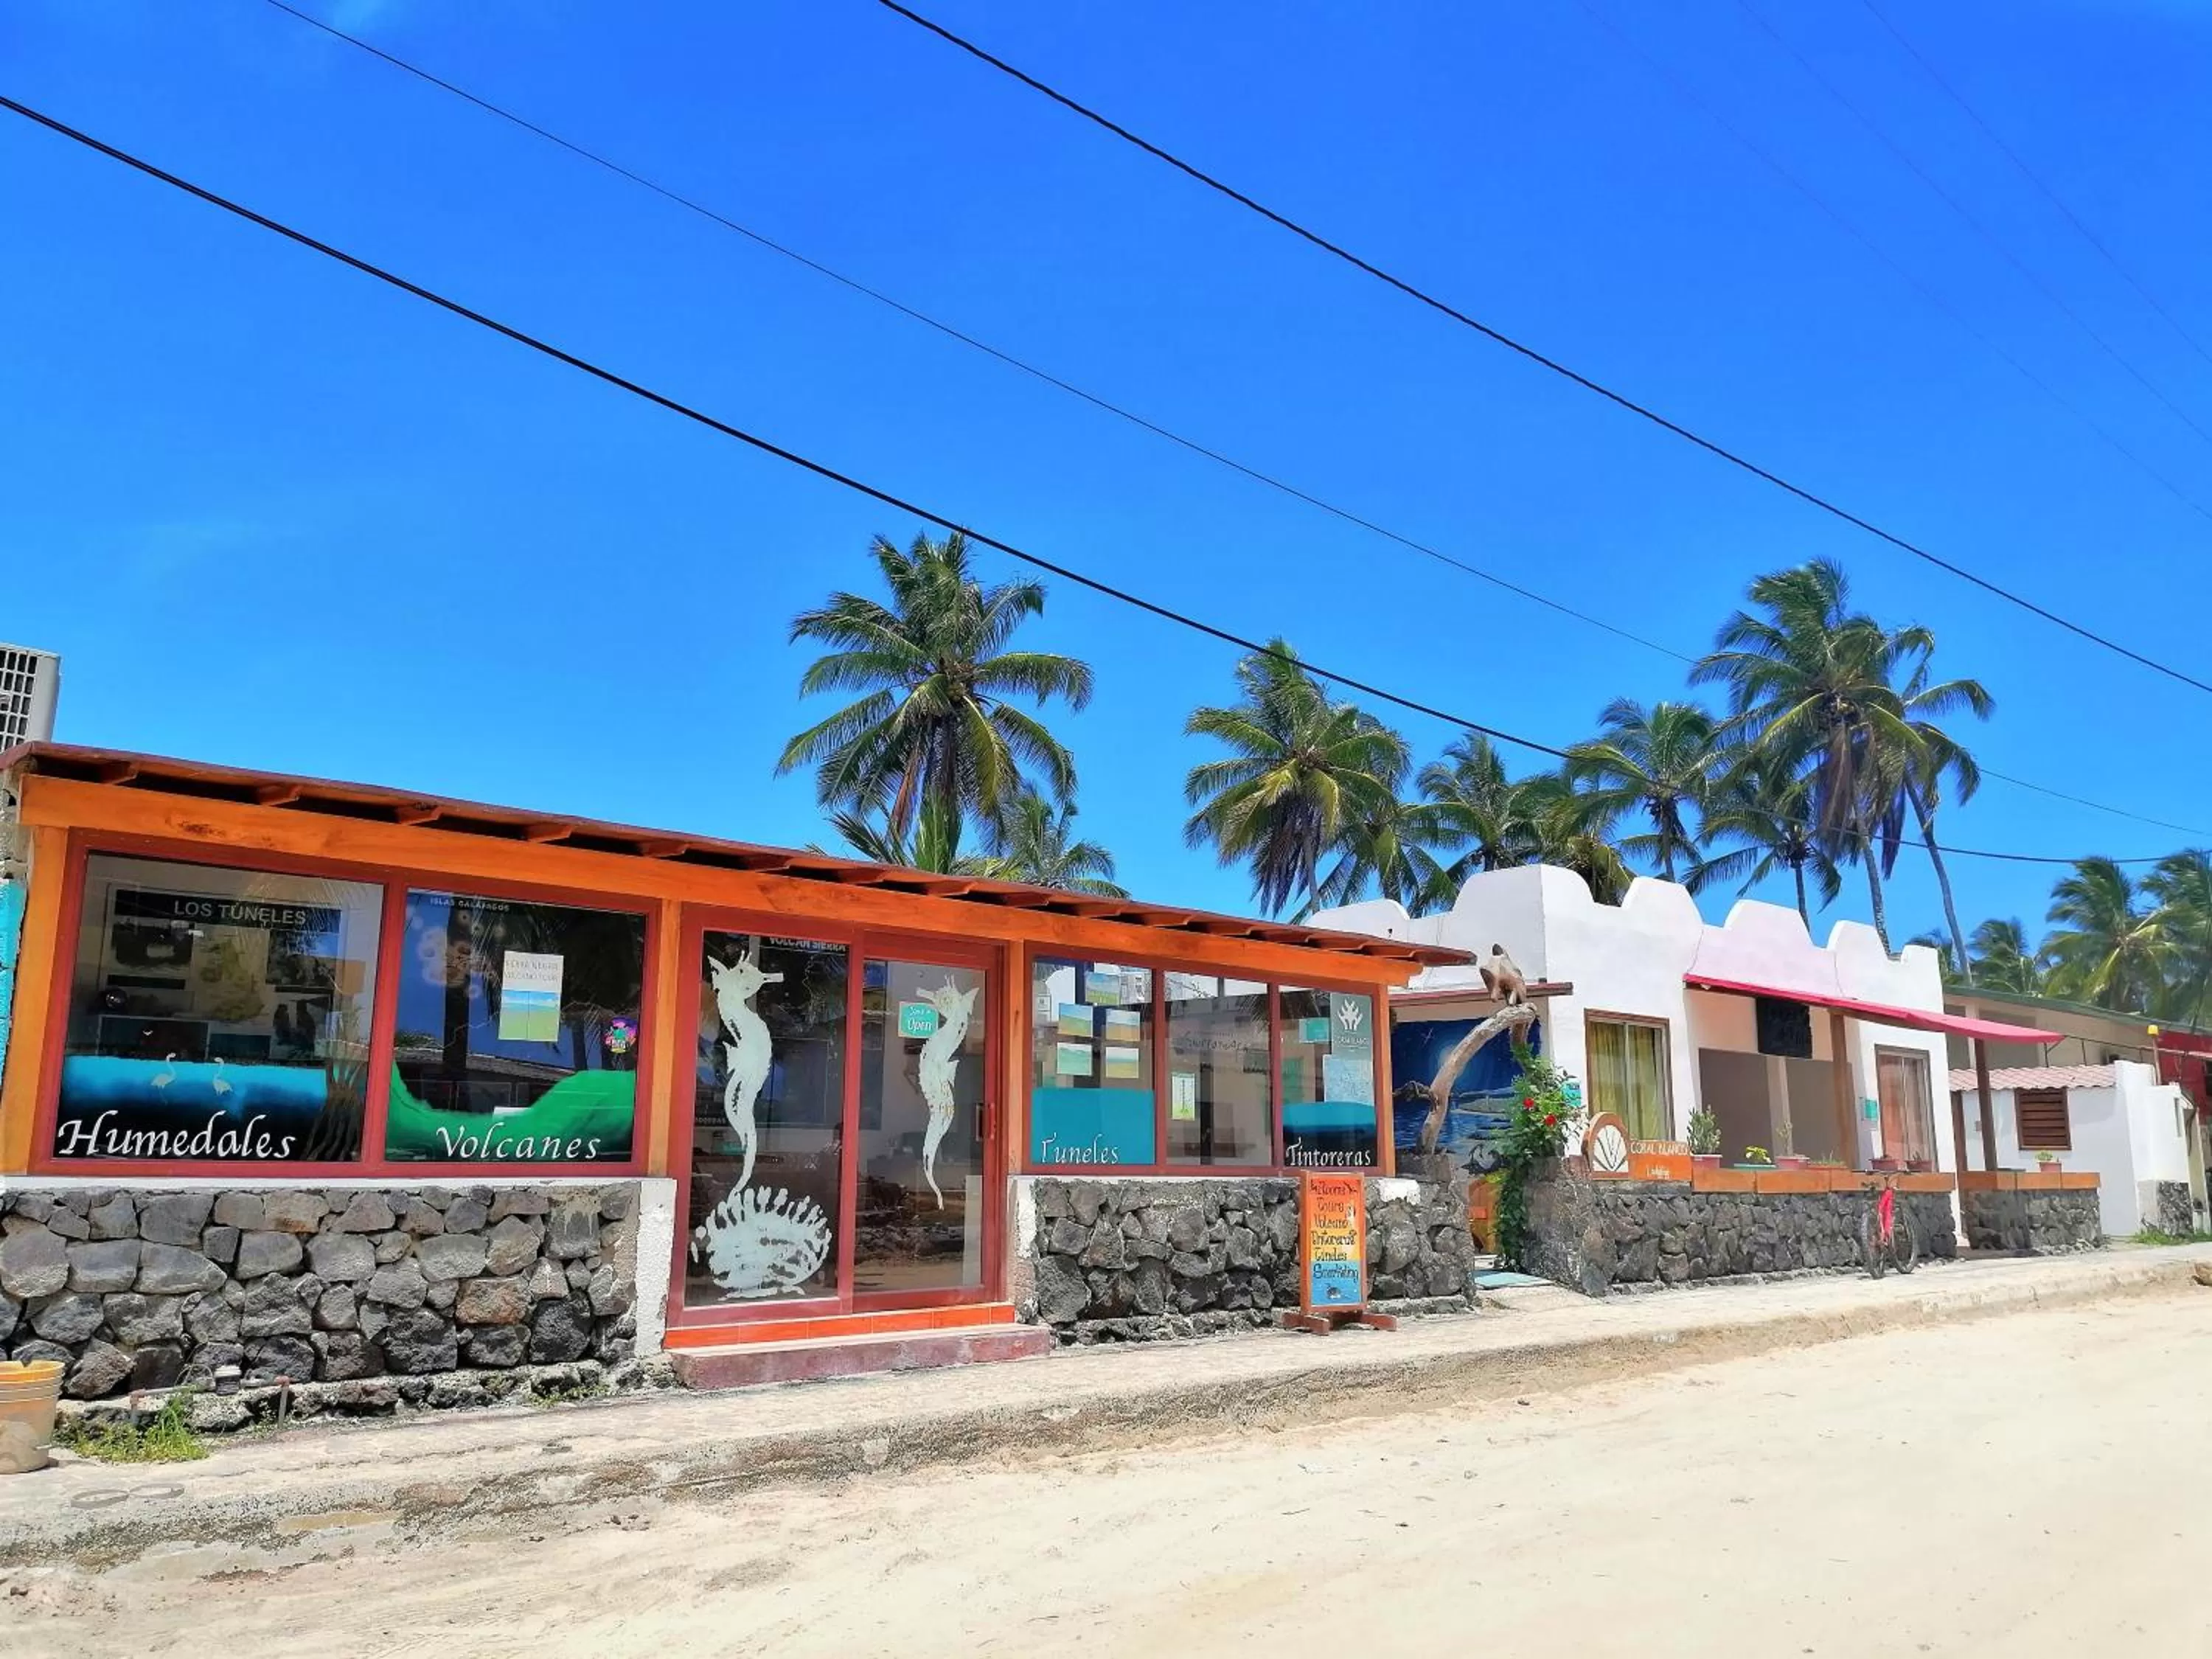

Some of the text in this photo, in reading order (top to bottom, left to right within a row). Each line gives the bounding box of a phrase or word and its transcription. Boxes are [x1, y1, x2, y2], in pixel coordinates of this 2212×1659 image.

[174, 900, 212, 917] LOS
[58, 1110, 296, 1158] Humedales
[436, 1121, 601, 1159] Volcanes
[1041, 1132, 1119, 1164] Tuneles
[1285, 1136, 1371, 1166] Tintoreras
